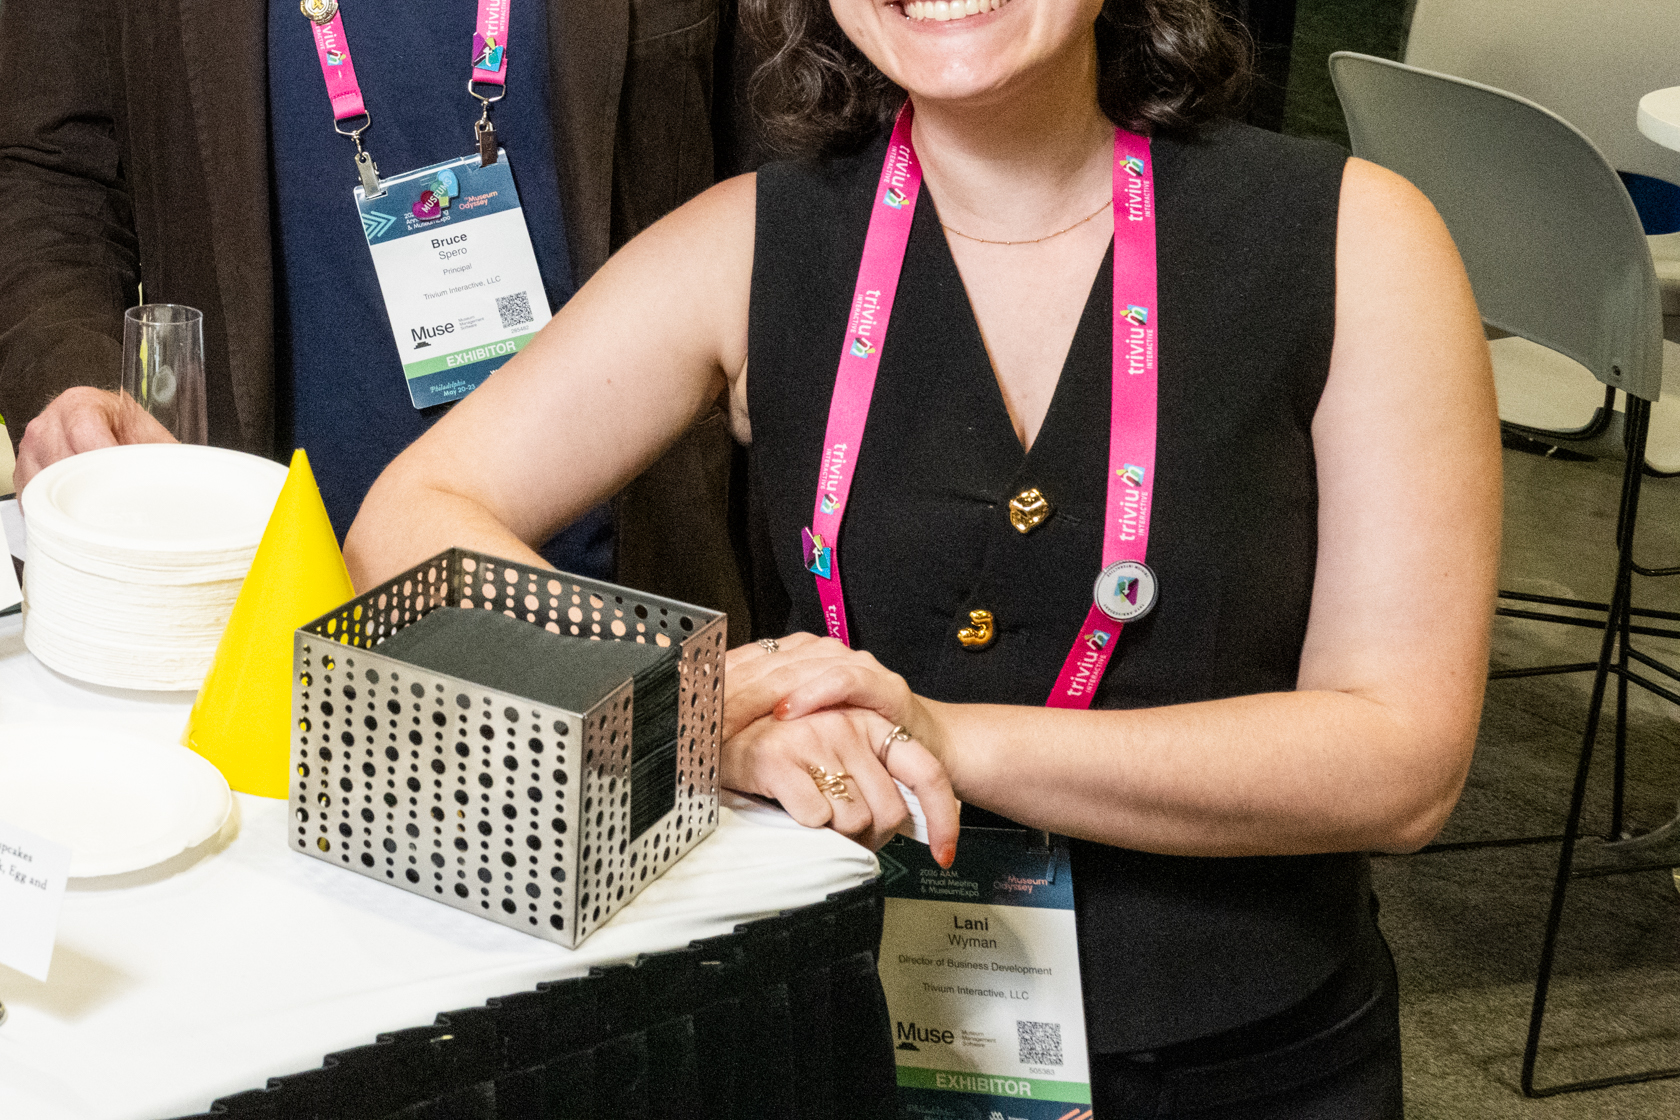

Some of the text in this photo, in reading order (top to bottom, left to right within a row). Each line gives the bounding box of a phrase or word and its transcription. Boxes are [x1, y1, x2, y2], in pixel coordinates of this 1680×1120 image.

[884, 145, 913, 207] trivium
[421, 177, 453, 213] MUSEUMS
[468, 191, 498, 202] Museum
[1123, 156, 1144, 222] trivium
[459, 198, 488, 210] Odyssey
[431, 232, 468, 249] Bruce
[438, 246, 468, 261] Spero
[443, 263, 473, 276] Principal
[423, 275, 501, 301] Trivium Interactive, LLC
[411, 322, 455, 342] Muse
[851, 290, 881, 357] trivium
[1125, 305, 1148, 375] trivium
[446, 341, 516, 367] EXHIBITOR
[430, 380, 466, 393] Philadelphia
[458, 384, 475, 393] 20-23
[821, 443, 847, 513] trivium
[1119, 465, 1144, 542] trivium
[1067, 630, 1109, 697] trivium
[8, 865, 27, 884] Egg
[29, 875, 47, 890] and
[921, 877, 979, 890] Annual Meeting
[993, 881, 1033, 894] Odyssey
[1008, 875, 1048, 886] Museum
[929, 887, 979, 897] MuseumExpo
[954, 915, 989, 931] Lani
[948, 933, 997, 950] Wyman
[898, 954, 1052, 976] Director of Business Development
[922, 982, 1029, 1000] Trivium Interactive, LLC
[897, 1021, 954, 1045] Muse
[936, 1073, 1031, 1096] EXHIBITOR
